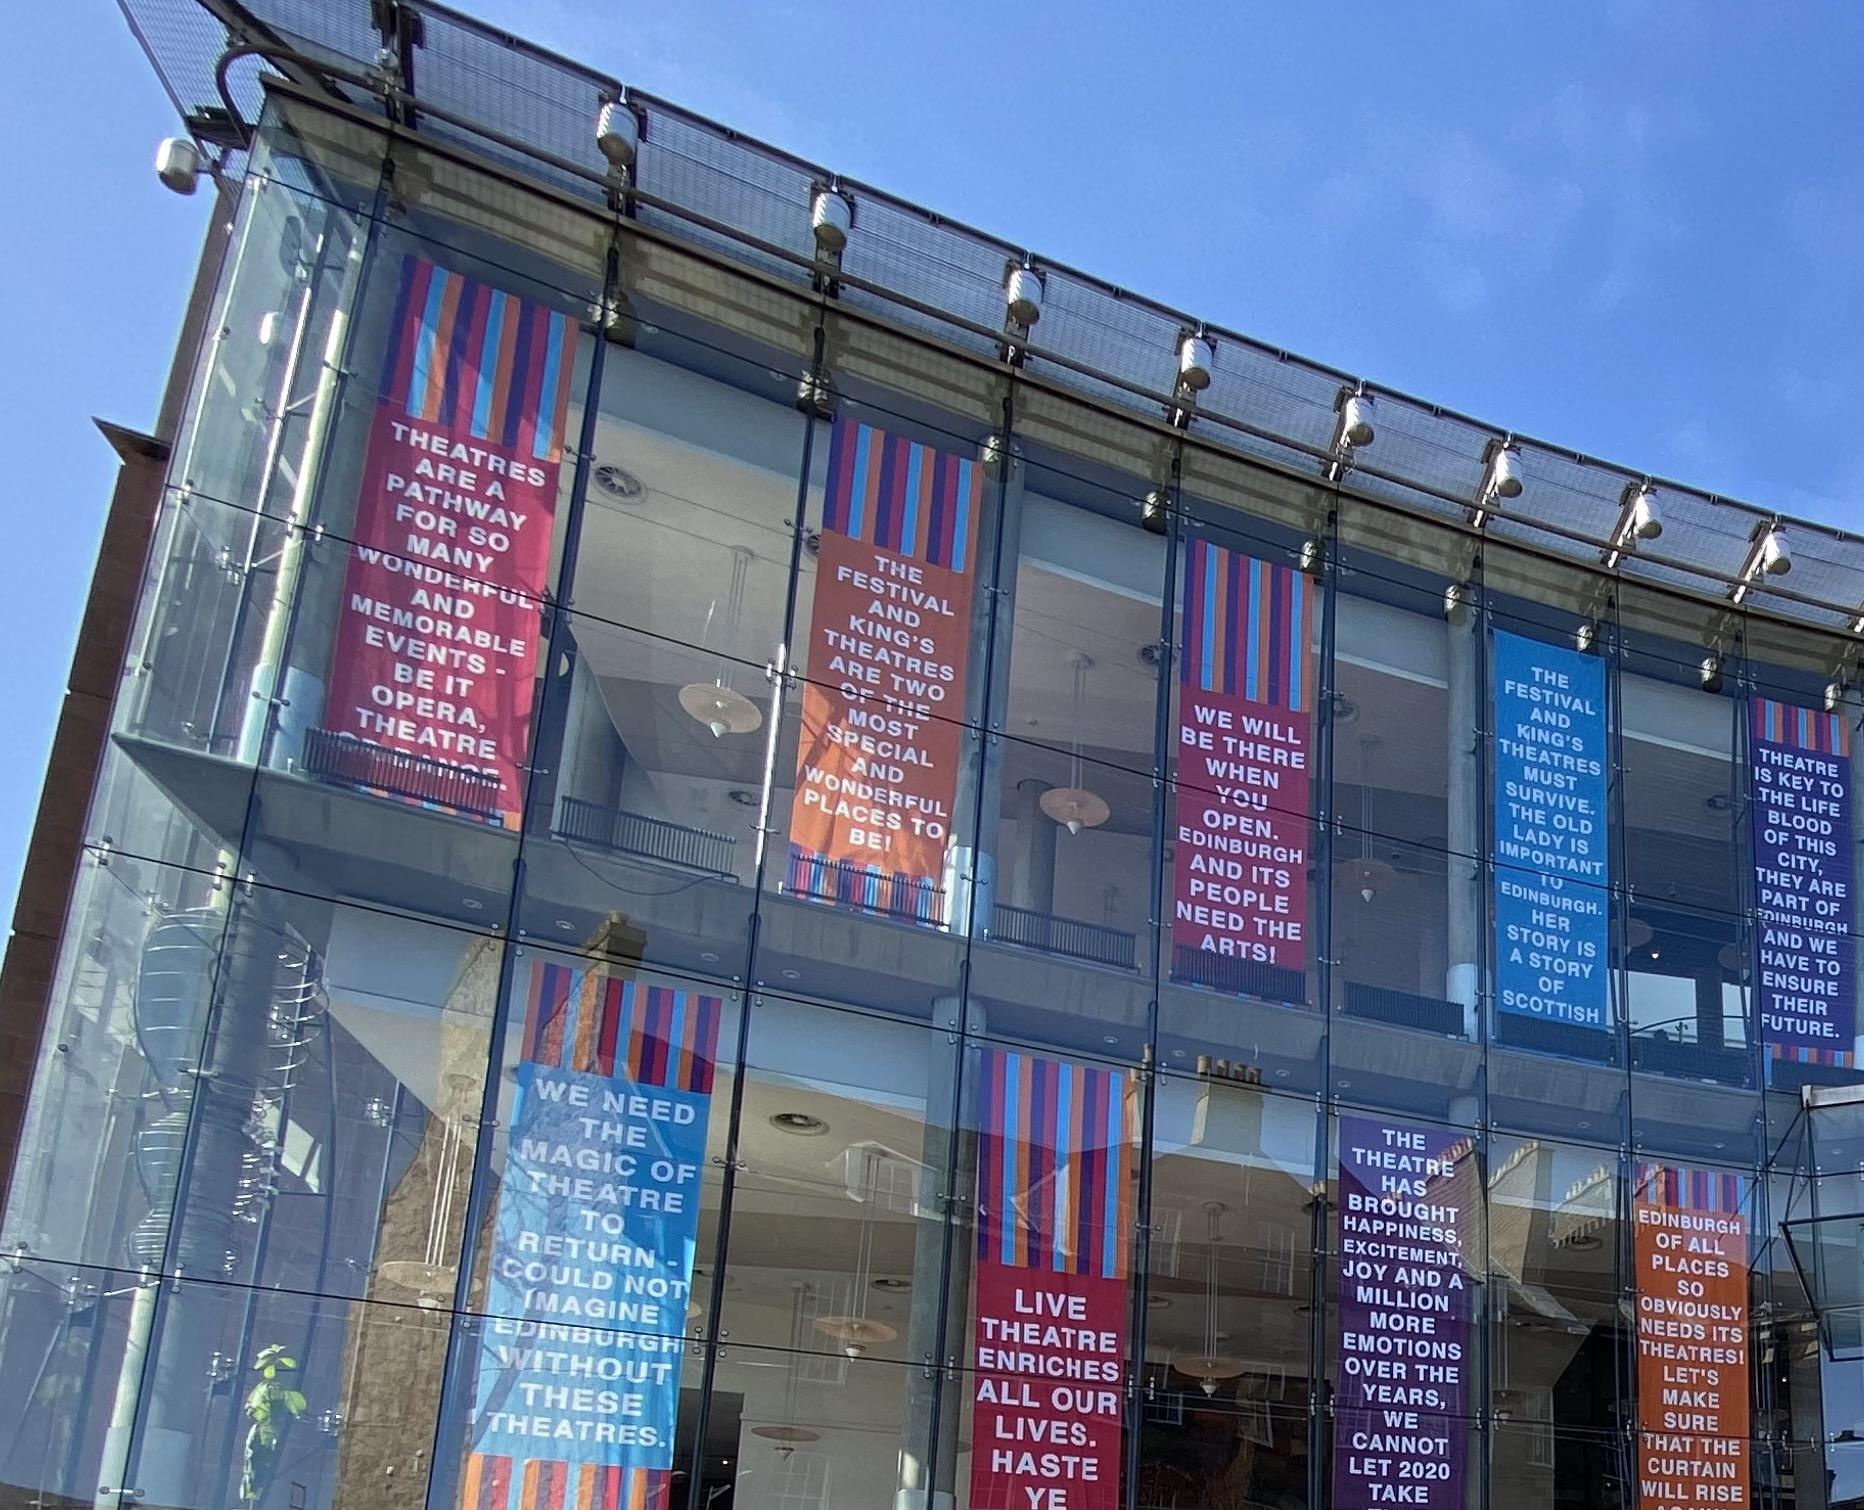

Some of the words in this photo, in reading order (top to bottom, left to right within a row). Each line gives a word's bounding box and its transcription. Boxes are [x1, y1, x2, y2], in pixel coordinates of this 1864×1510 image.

[390, 421, 545, 487] THEATRES
[415, 457, 475, 497] ARE
[486, 480, 506, 501] A
[386, 473, 527, 532] PATHWAY
[875, 554, 922, 584] THE
[410, 585, 475, 620] AND
[837, 565, 954, 616] FESTIVAL
[351, 594, 526, 658] MEMORABLE
[824, 629, 954, 681] THEATRES
[829, 655, 880, 684] ARE
[889, 674, 944, 701] TWO
[372, 684, 486, 732] OPERA,
[1505, 680, 1595, 716] FESTIVAL
[356, 706, 496, 760] THEATRE
[1194, 705, 1232, 729] WE
[1242, 715, 1301, 744] WILL
[826, 724, 933, 768] SPECIAL
[1206, 757, 1279, 790] WHEN
[1524, 766, 1577, 791] MUST
[1760, 749, 1838, 778] THEATRE
[805, 764, 947, 818] WONDERFUL
[1754, 766, 1772, 783] IS
[1779, 772, 1813, 792] KEY
[1820, 780, 1844, 797] TO
[1506, 782, 1594, 816] SURVIVE.
[1203, 810, 1278, 840] OPEN.
[1508, 802, 1546, 826] THE
[1554, 813, 1593, 835] OLD
[1768, 810, 1832, 835] BLOOD
[849, 827, 891, 852] BE!
[1179, 826, 1302, 864] EDINBURGH
[1513, 824, 1563, 852] LADY
[1571, 836, 1589, 855] IS
[1778, 852, 1822, 876] CITY,
[1190, 879, 1289, 914] PEOPLE
[1177, 900, 1244, 931] NEED
[1253, 916, 1301, 941] THE
[1763, 972, 1838, 997] ENSURE
[1503, 990, 1599, 1024] SCOTTISH
[1772, 994, 1827, 1015] THEIR
[536, 1079, 589, 1108] WE
[603, 1093, 695, 1125] NEED
[580, 1117, 647, 1148] THE
[1382, 1129, 1426, 1151] THE
[520, 1140, 637, 1176] MAGIC
[650, 1160, 696, 1184] OF
[1352, 1147, 1454, 1178] THEATRE
[527, 1170, 683, 1214] THEATRE
[1381, 1175, 1427, 1196] HAS
[1349, 1194, 1458, 1224] BROUGHT
[1639, 1210, 1740, 1235] EDINBURGH
[1344, 1216, 1463, 1247] HAPPINESS,
[1656, 1232, 1682, 1249] OF
[1688, 1237, 1725, 1256] ALL
[1343, 1239, 1463, 1268] EXCITEMENT,
[1652, 1256, 1729, 1278] PLACES
[525, 1288, 660, 1325] IMAGINE
[1016, 1289, 1086, 1320] LIVE
[1357, 1285, 1449, 1312] MILLION
[1641, 1297, 1742, 1321] OBVIOUSLY
[981, 1317, 1117, 1353] THEATRE
[1343, 1333, 1462, 1360] EMOTIONS
[500, 1346, 672, 1385] WITHOUT
[979, 1347, 1119, 1382] ENRICHES
[1640, 1339, 1745, 1365] THEATRES!
[1664, 1365, 1719, 1386] LET'S
[520, 1383, 643, 1417] THESE
[977, 1379, 1039, 1408] ALL
[1052, 1387, 1117, 1415] OUR
[487, 1411, 666, 1449] THEATRES.
[996, 1415, 1096, 1447] LIVES.
[992, 1449, 1098, 1481] HASTE
[1349, 1457, 1392, 1476] LET
[1399, 1461, 1450, 1480] 2020
